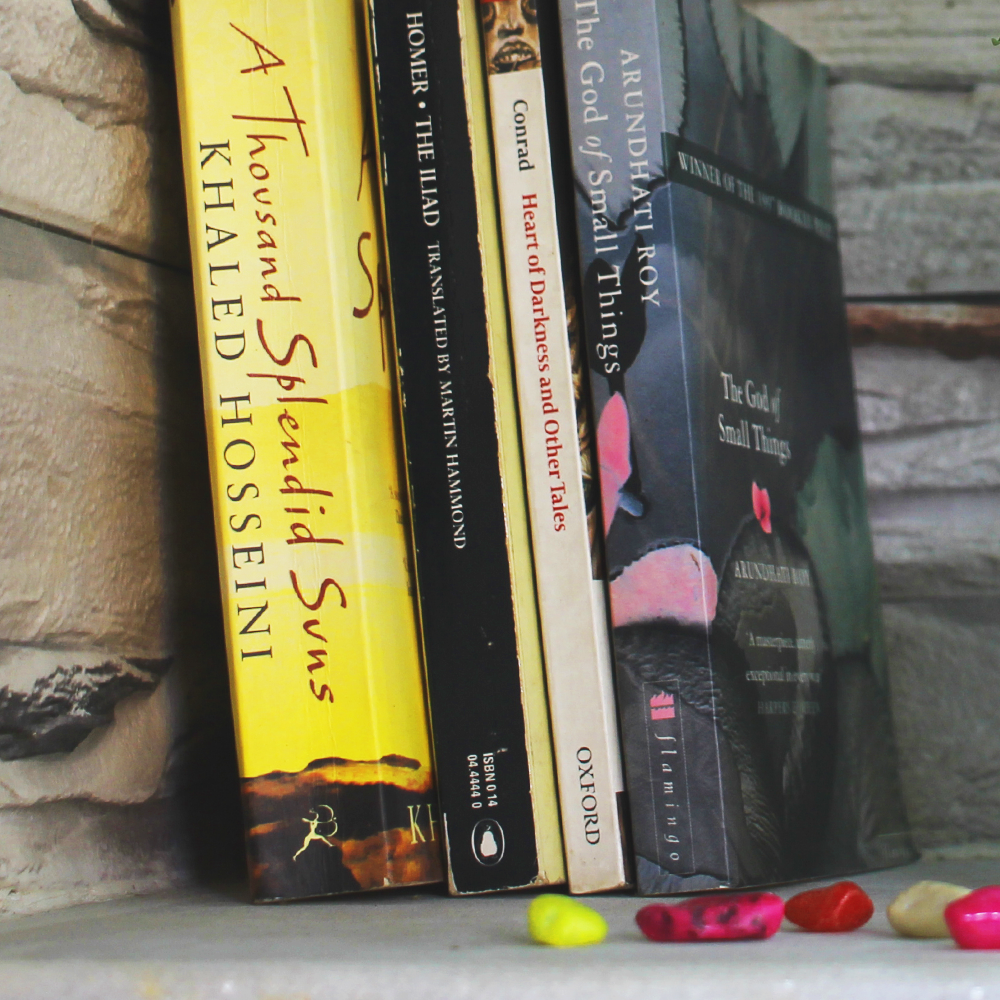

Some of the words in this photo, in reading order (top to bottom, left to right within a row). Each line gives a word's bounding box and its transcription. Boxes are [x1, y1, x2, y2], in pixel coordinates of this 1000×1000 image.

[229, 22, 286, 76] A
[406, 12, 429, 95] HOMER
[580, 60, 609, 124] God
[415, 115, 435, 163] THE
[513, 99, 535, 172] Conrad
[578, 135, 613, 163] of
[231, 85, 309, 302] Thousand
[419, 168, 440, 227] ILIAD
[620, 49, 654, 231] ARUNDHATI
[637, 244, 661, 307] ROY
[522, 193, 540, 250] Heart
[588, 169, 619, 255] Small
[199, 139, 247, 361] KHALED
[527, 254, 546, 276] of
[427, 240, 448, 349] TRANSLATED
[530, 280, 551, 373] Darkness
[596, 264, 622, 374] Things
[437, 353, 451, 375] BY
[540, 376, 559, 414] and
[720, 371, 743, 405] The
[745, 379, 770, 413] God
[246, 318, 345, 546] Splendid
[439, 380, 458, 449] MARTIN
[718, 413, 751, 449] Small
[544, 419, 563, 479] Other
[219, 394, 273, 662] HOSSEINI
[446, 453, 467, 550] HAMMOND
[550, 481, 569, 532] Tales
[289, 569, 347, 704] Suns
[482, 752, 496, 782] ISBN
[486, 784, 497, 792] 0
[576, 746, 600, 845] OXFORD
[654, 733, 680, 861] flamingo
[471, 801, 482, 809] 0
[487, 794, 498, 807] 14
